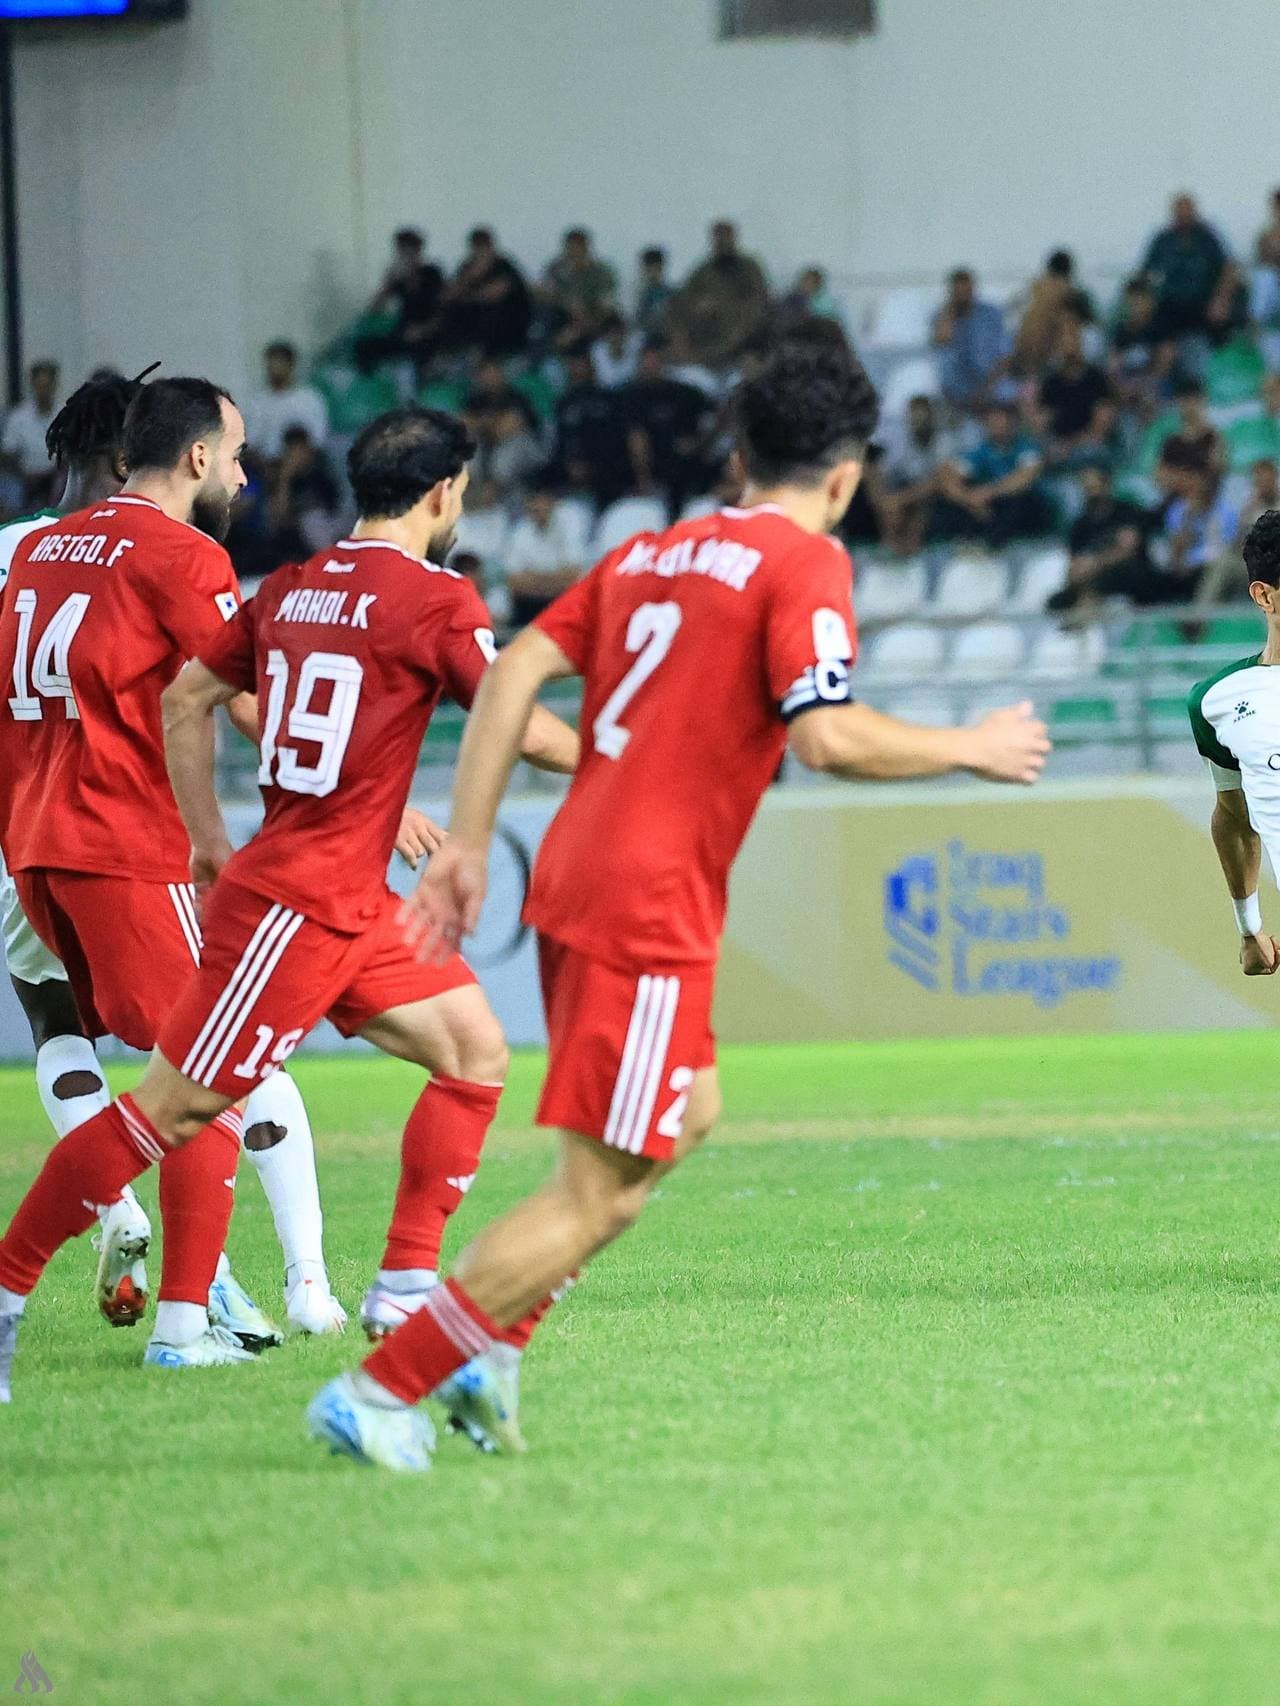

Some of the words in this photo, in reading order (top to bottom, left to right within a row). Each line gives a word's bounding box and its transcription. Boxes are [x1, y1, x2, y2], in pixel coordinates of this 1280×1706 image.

[27, 534, 135, 568] RASTGO.F
[274, 588, 378, 630] MAHDI.K
[8, 588, 92, 721] 14
[593, 600, 682, 760] 2
[815, 661, 849, 701] C
[258, 649, 364, 798] 19
[233, 1024, 304, 1079] 19
[656, 1065, 694, 1139] 2
